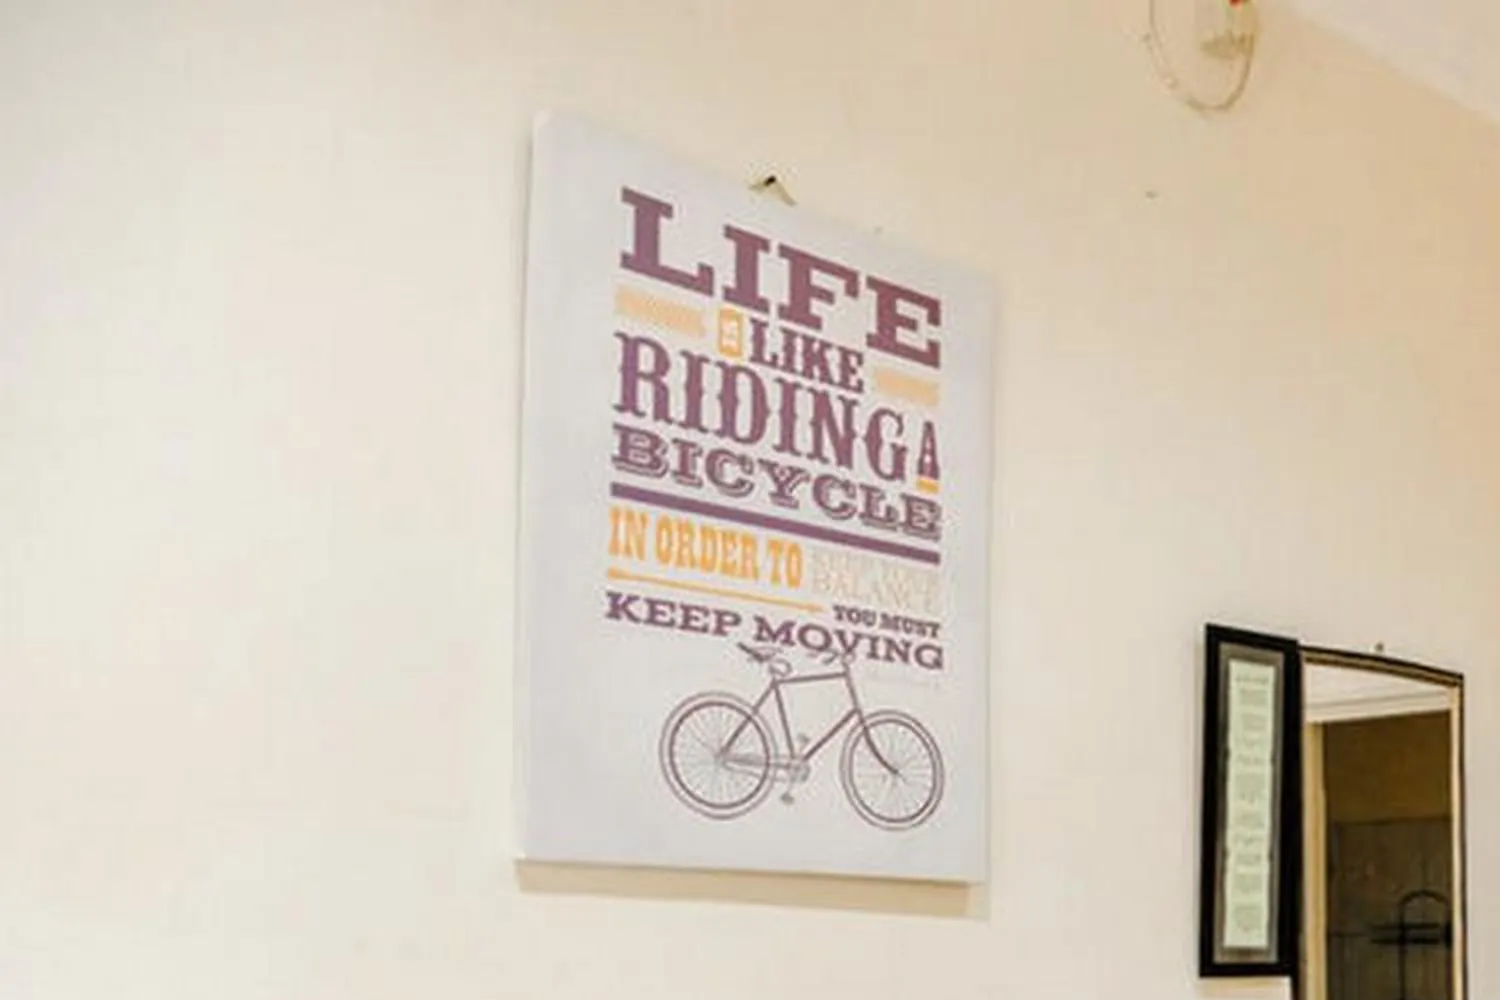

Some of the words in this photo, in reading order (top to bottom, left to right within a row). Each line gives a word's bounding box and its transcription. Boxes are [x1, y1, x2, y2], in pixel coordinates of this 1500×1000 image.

[620, 186, 941, 369] LIFE
[750, 318, 864, 394] LIKE
[613, 332, 907, 482] RIDING
[918, 421, 940, 480] A
[611, 423, 942, 541] BICYCLE
[609, 507, 649, 561] IN
[655, 516, 758, 580] ORDER
[768, 540, 803, 589] TO
[606, 592, 741, 636] KEEP
[754, 615, 944, 670] MOVING
[833, 605, 876, 629] YOU
[879, 613, 941, 638] MUST
